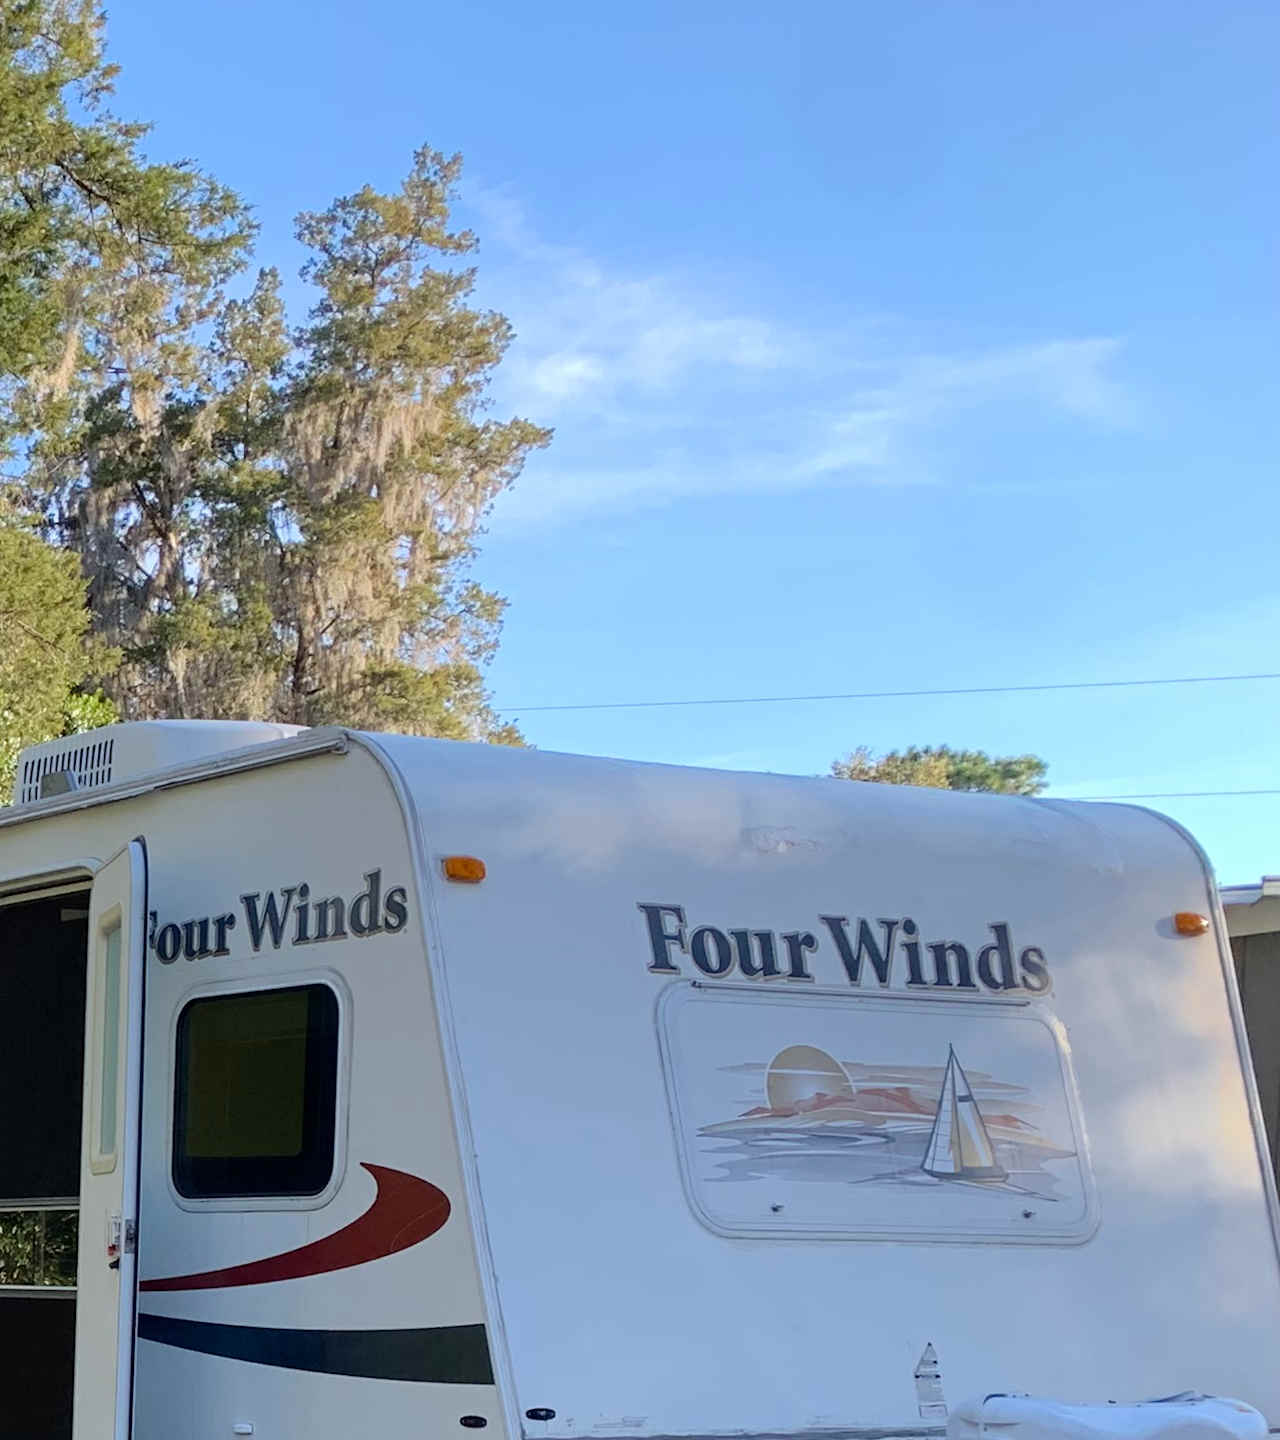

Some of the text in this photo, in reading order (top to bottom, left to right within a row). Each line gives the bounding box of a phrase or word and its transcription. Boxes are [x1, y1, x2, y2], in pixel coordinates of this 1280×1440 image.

[239, 867, 410, 952] Winds
[637, 901, 1054, 994] Four Winds
